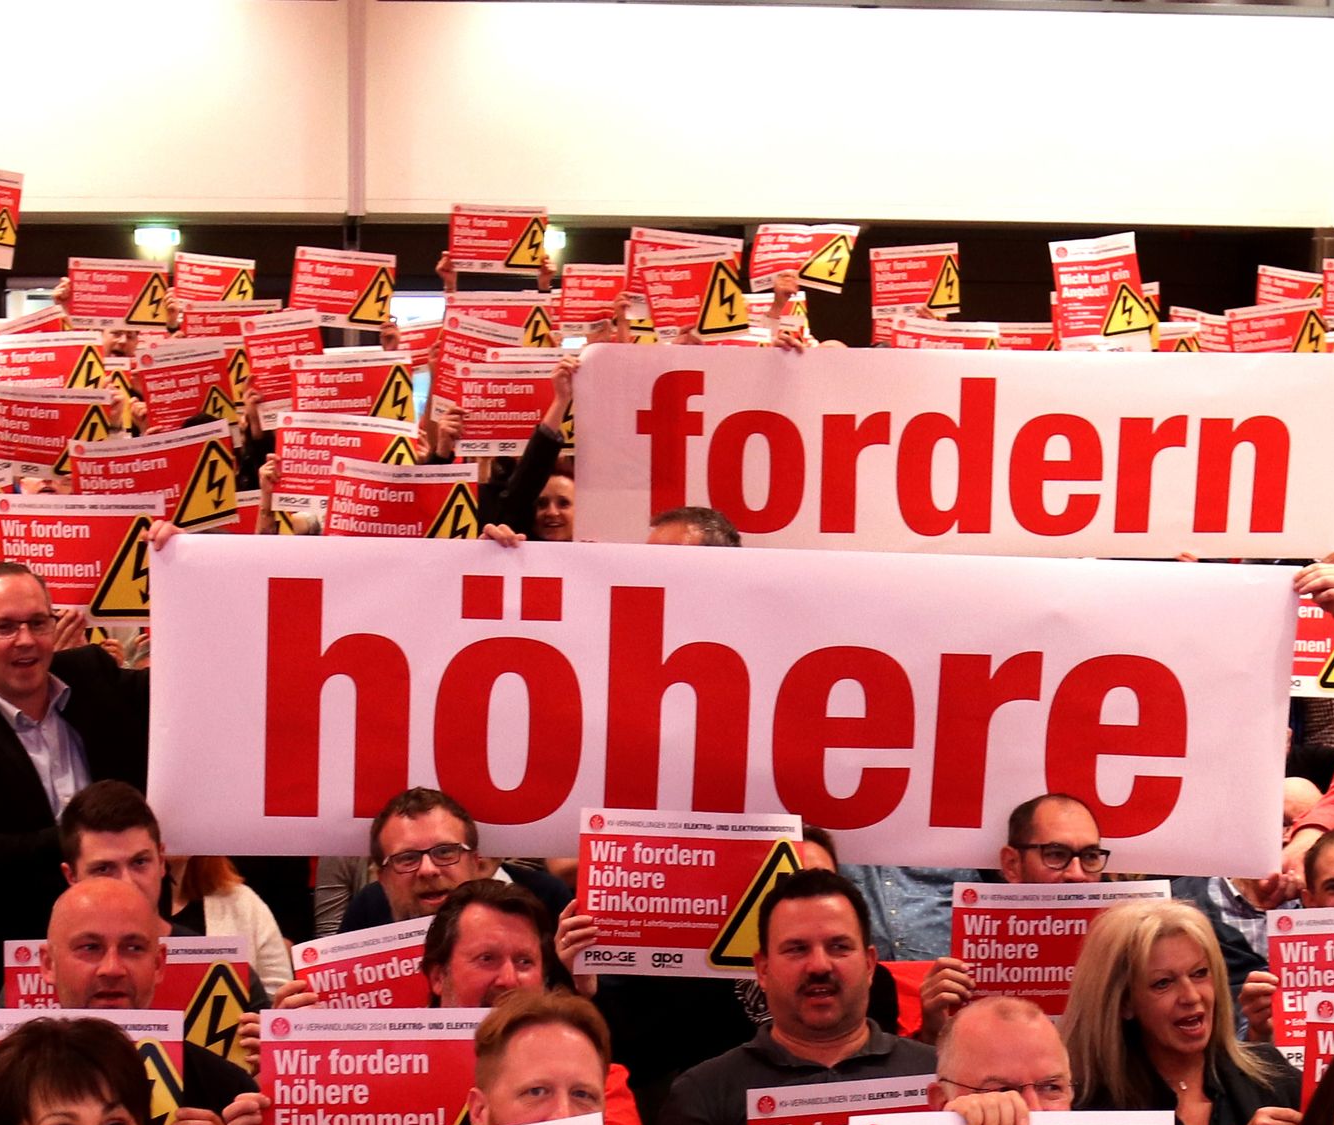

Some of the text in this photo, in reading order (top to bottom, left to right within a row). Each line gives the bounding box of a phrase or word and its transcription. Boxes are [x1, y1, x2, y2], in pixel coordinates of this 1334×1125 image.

[637, 370, 1289, 535] fordern
[265, 575, 1188, 838] höhere
[590, 840, 716, 867] Wir fordern
[588, 864, 666, 890] höhere
[587, 889, 729, 917] Einkommen!
[585, 951, 683, 968] PRO-GE gpa
[273, 1048, 430, 1075] Wir fordern
[273, 1079, 370, 1106] höhere
